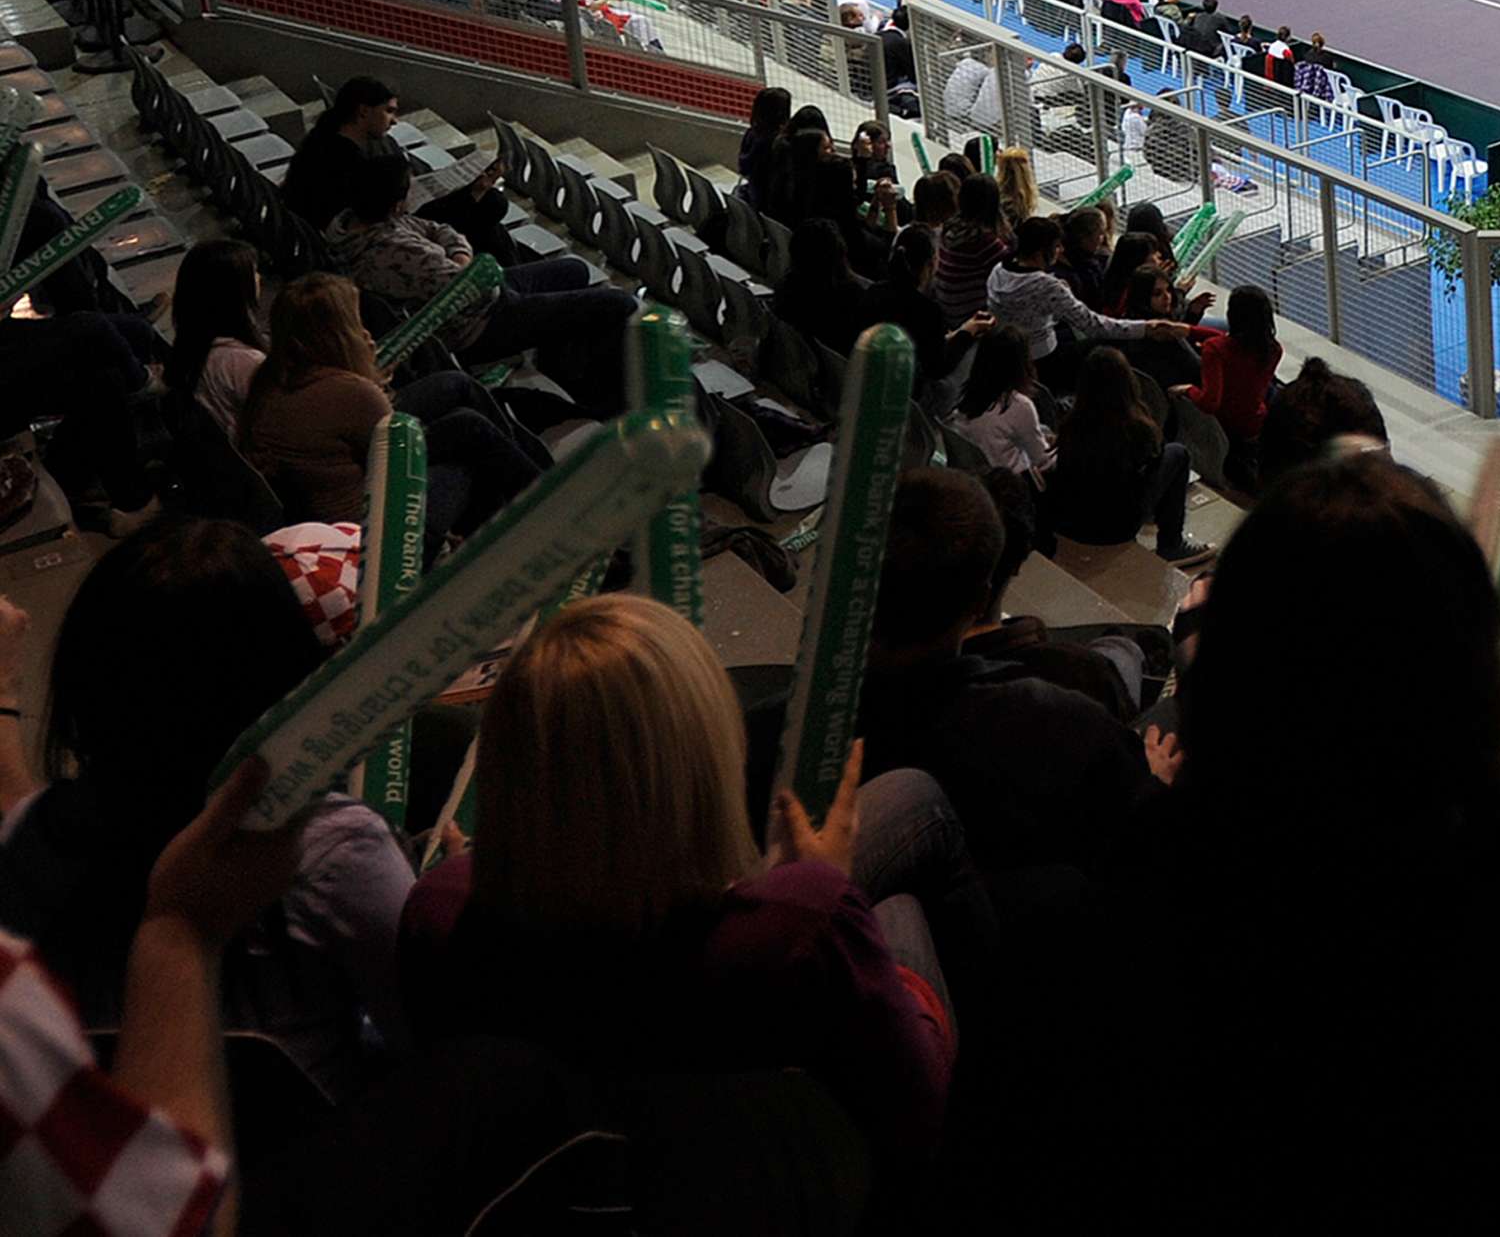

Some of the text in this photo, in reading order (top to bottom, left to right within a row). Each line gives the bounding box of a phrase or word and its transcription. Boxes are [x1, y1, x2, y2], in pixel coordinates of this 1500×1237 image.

[59, 209, 105, 248] BNP
[404, 493, 422, 526] The
[665, 502, 692, 538] for
[401, 531, 420, 581] bank
[384, 738, 405, 803] world
